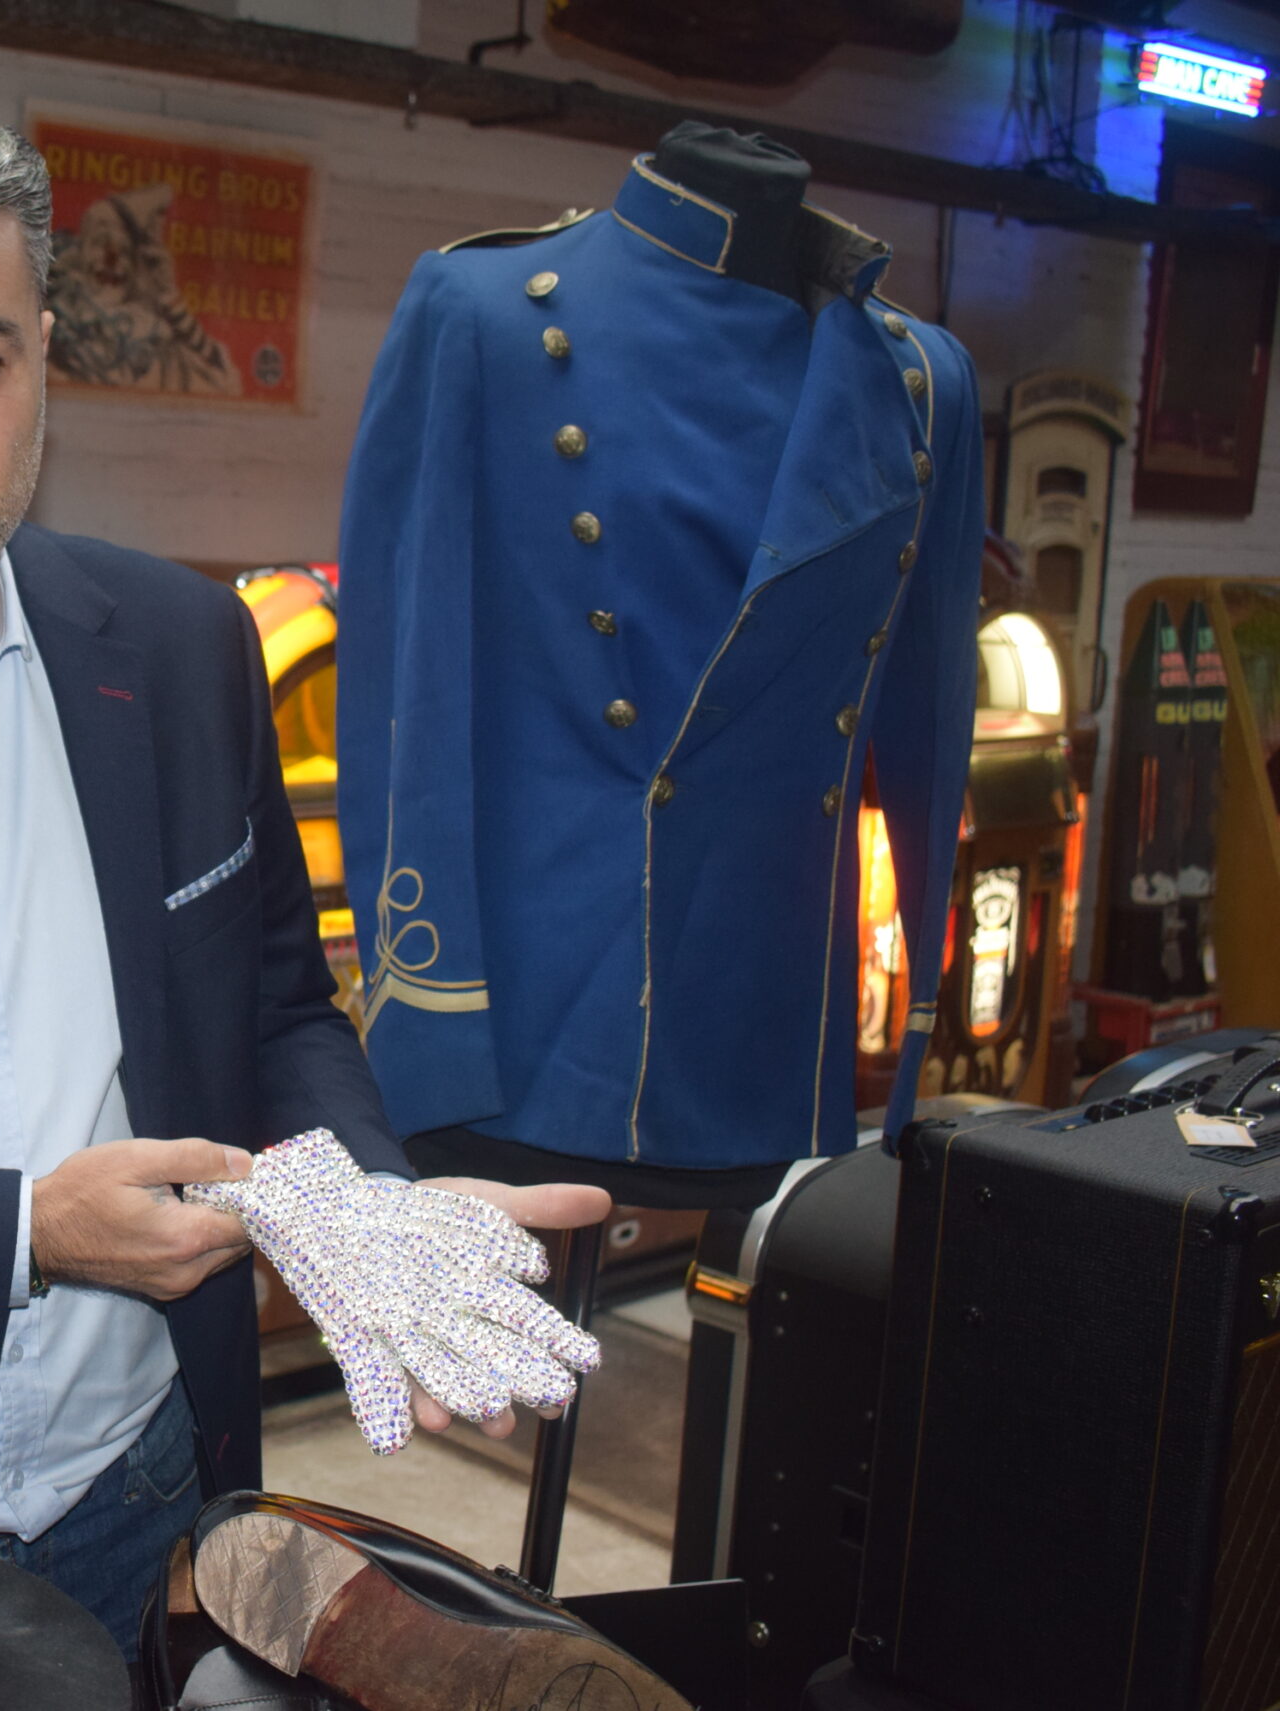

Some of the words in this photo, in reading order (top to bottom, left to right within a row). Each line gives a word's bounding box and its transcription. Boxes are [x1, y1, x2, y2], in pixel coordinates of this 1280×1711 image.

[45, 143, 210, 200] RINGLING
[218, 169, 300, 212] BROS
[170, 220, 296, 266] BARNUM
[183, 281, 290, 323] BAILEY
